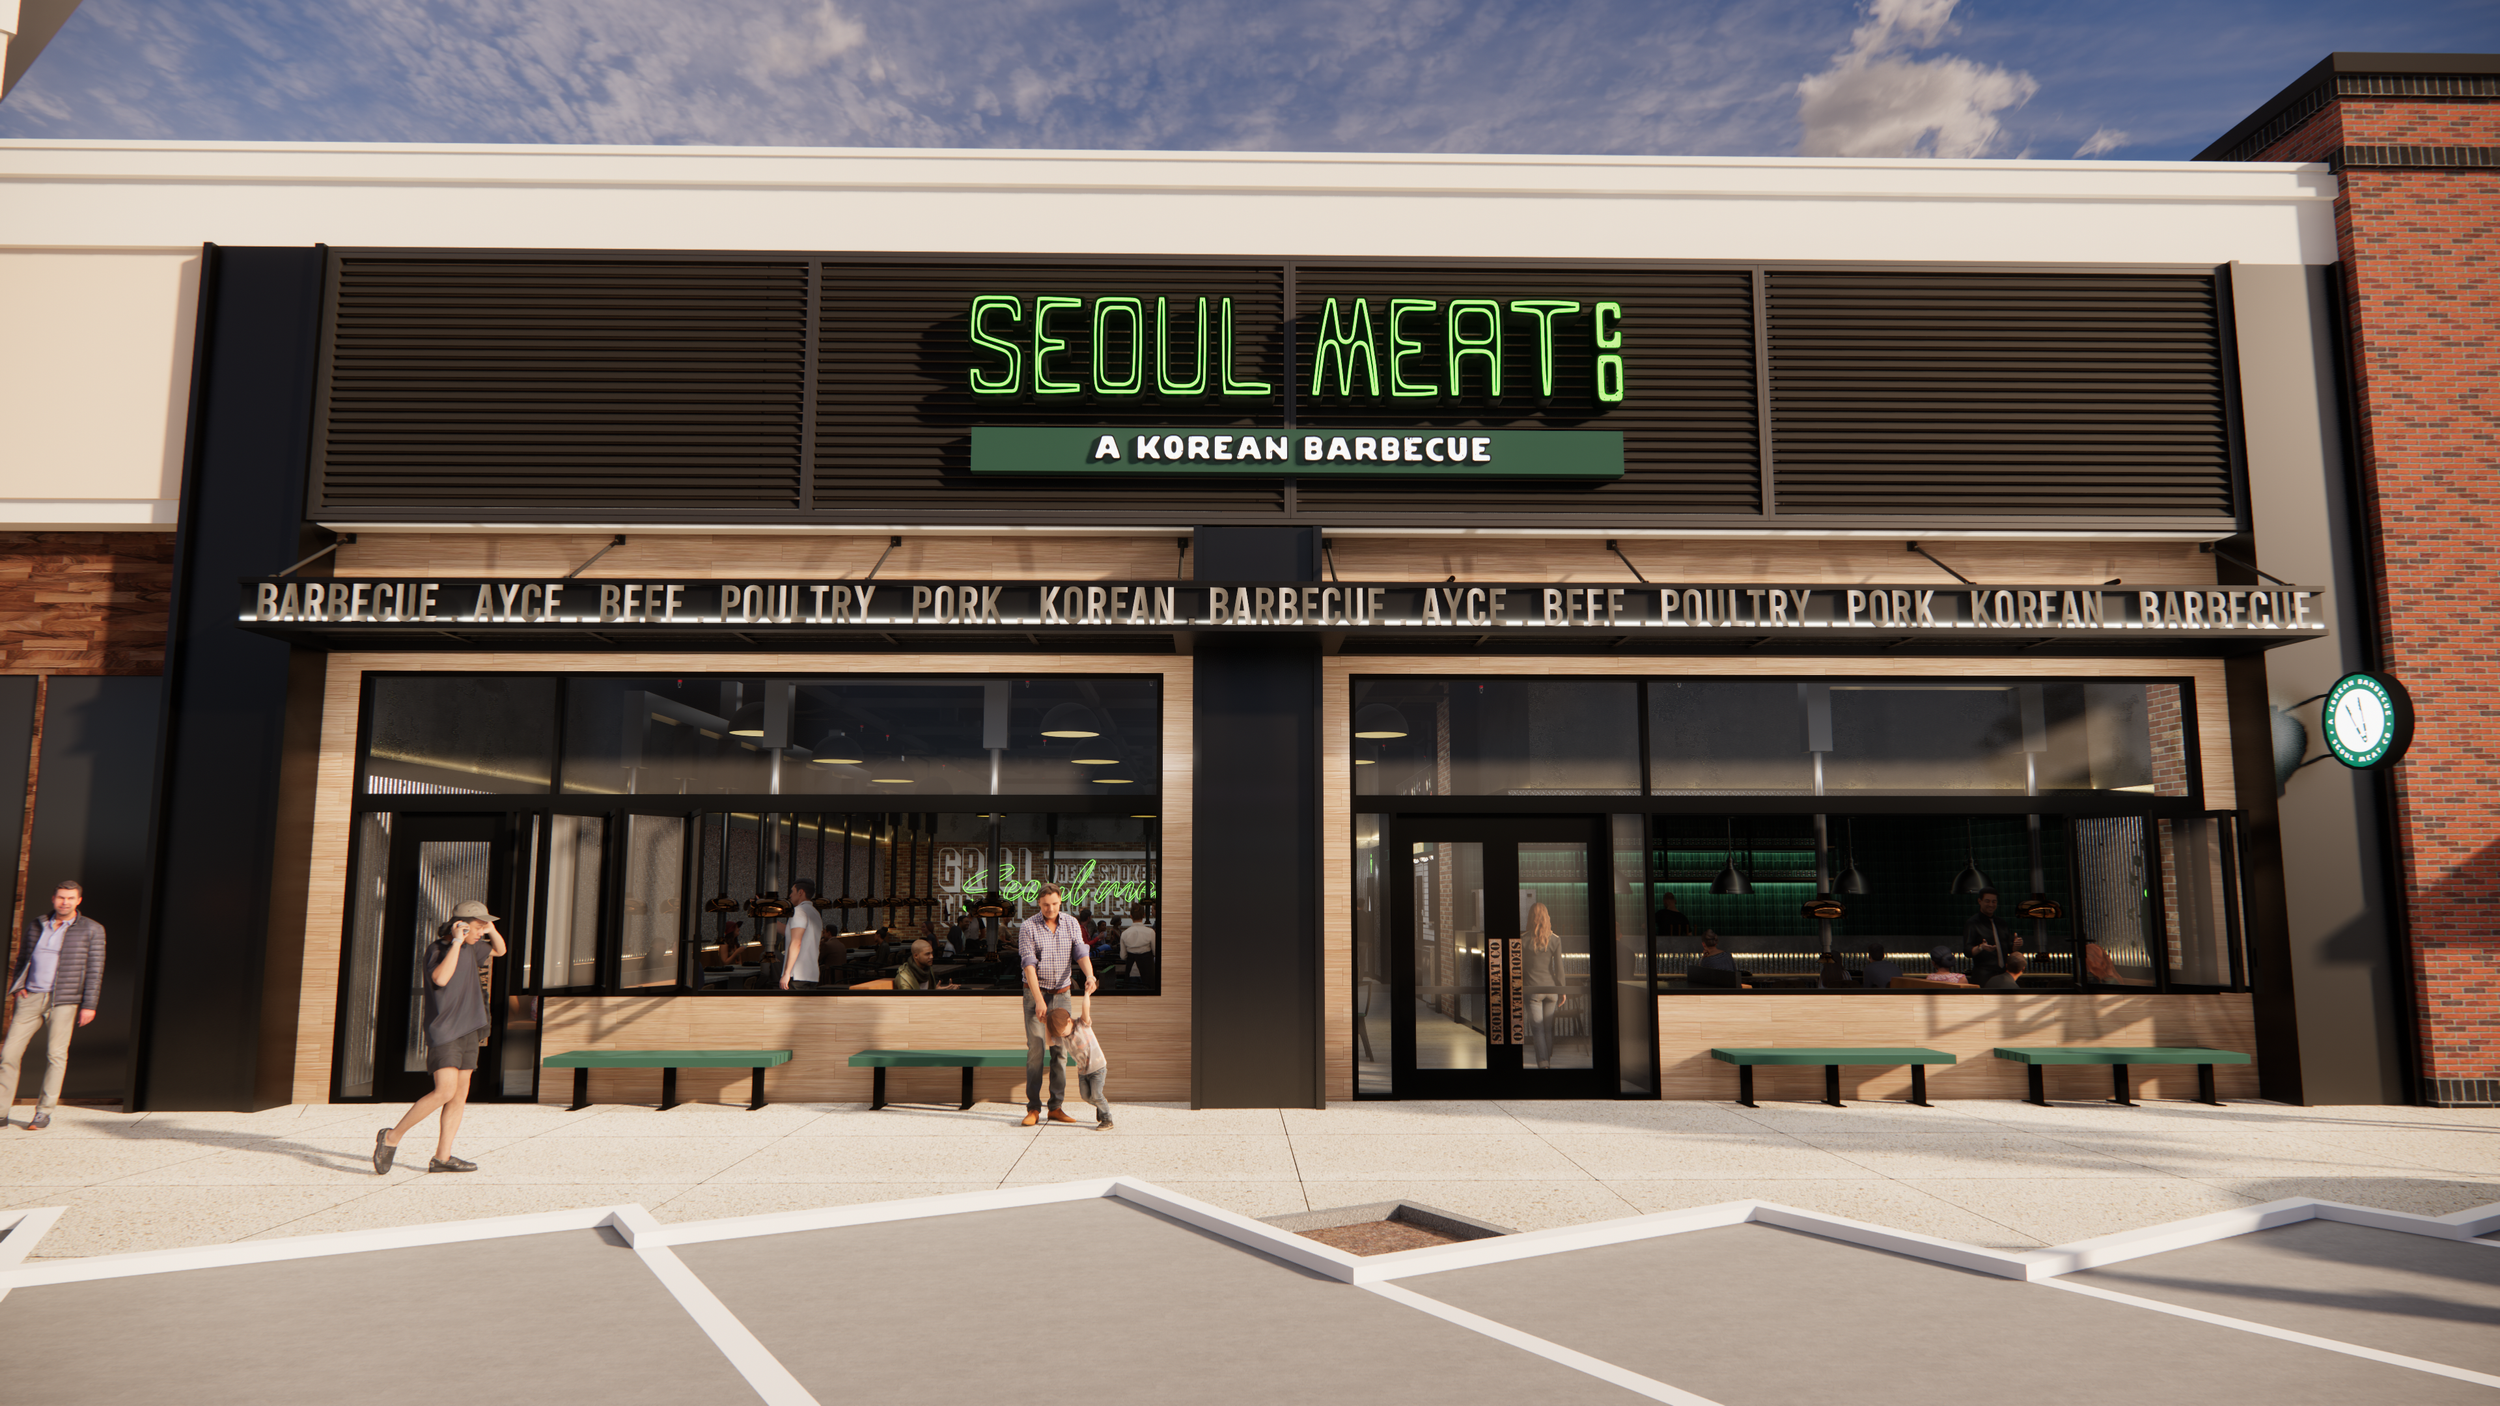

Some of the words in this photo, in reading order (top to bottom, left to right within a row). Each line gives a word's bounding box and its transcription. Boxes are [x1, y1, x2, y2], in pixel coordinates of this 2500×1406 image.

[970, 295, 1271, 395] SEOUL
[1312, 298, 1580, 397] MEAT
[1596, 302, 1624, 402] CO
[1094, 435, 1121, 460] A
[1136, 436, 1289, 461] KOREAN
[1304, 436, 1492, 462] BARBECUE
[256, 583, 440, 622] BARBECUE
[473, 583, 564, 622] AYCE
[600, 584, 685, 623] BEEF
[720, 584, 876, 624] POULTRY
[912, 585, 1003, 624] PORK
[1040, 586, 1175, 625] KOREAN
[1209, 587, 1385, 626] BARBECUE
[1422, 587, 1507, 626] AYCE
[1544, 588, 1625, 627] BEEF
[1660, 588, 1811, 628] POULTRY
[1847, 589, 1937, 628] PORK
[1971, 590, 2102, 628] KOREAN
[2139, 590, 2314, 629] BARBECUE
[2328, 680, 2354, 713] KOREAN
[2357, 678, 2392, 716] BARBECUE
[2332, 739, 2354, 761] SEOUL
[2358, 747, 2382, 763] MEAT
[938, 847, 1037, 893] GRLL
[1490, 942, 1501, 959] CO
[1511, 941, 1522, 983] SEOUL
[1490, 962, 1502, 997] MEAT
[1491, 1000, 1503, 1042] SEOUL
[1511, 986, 1523, 1020] MEAT
[1512, 1024, 1523, 1042] CO
